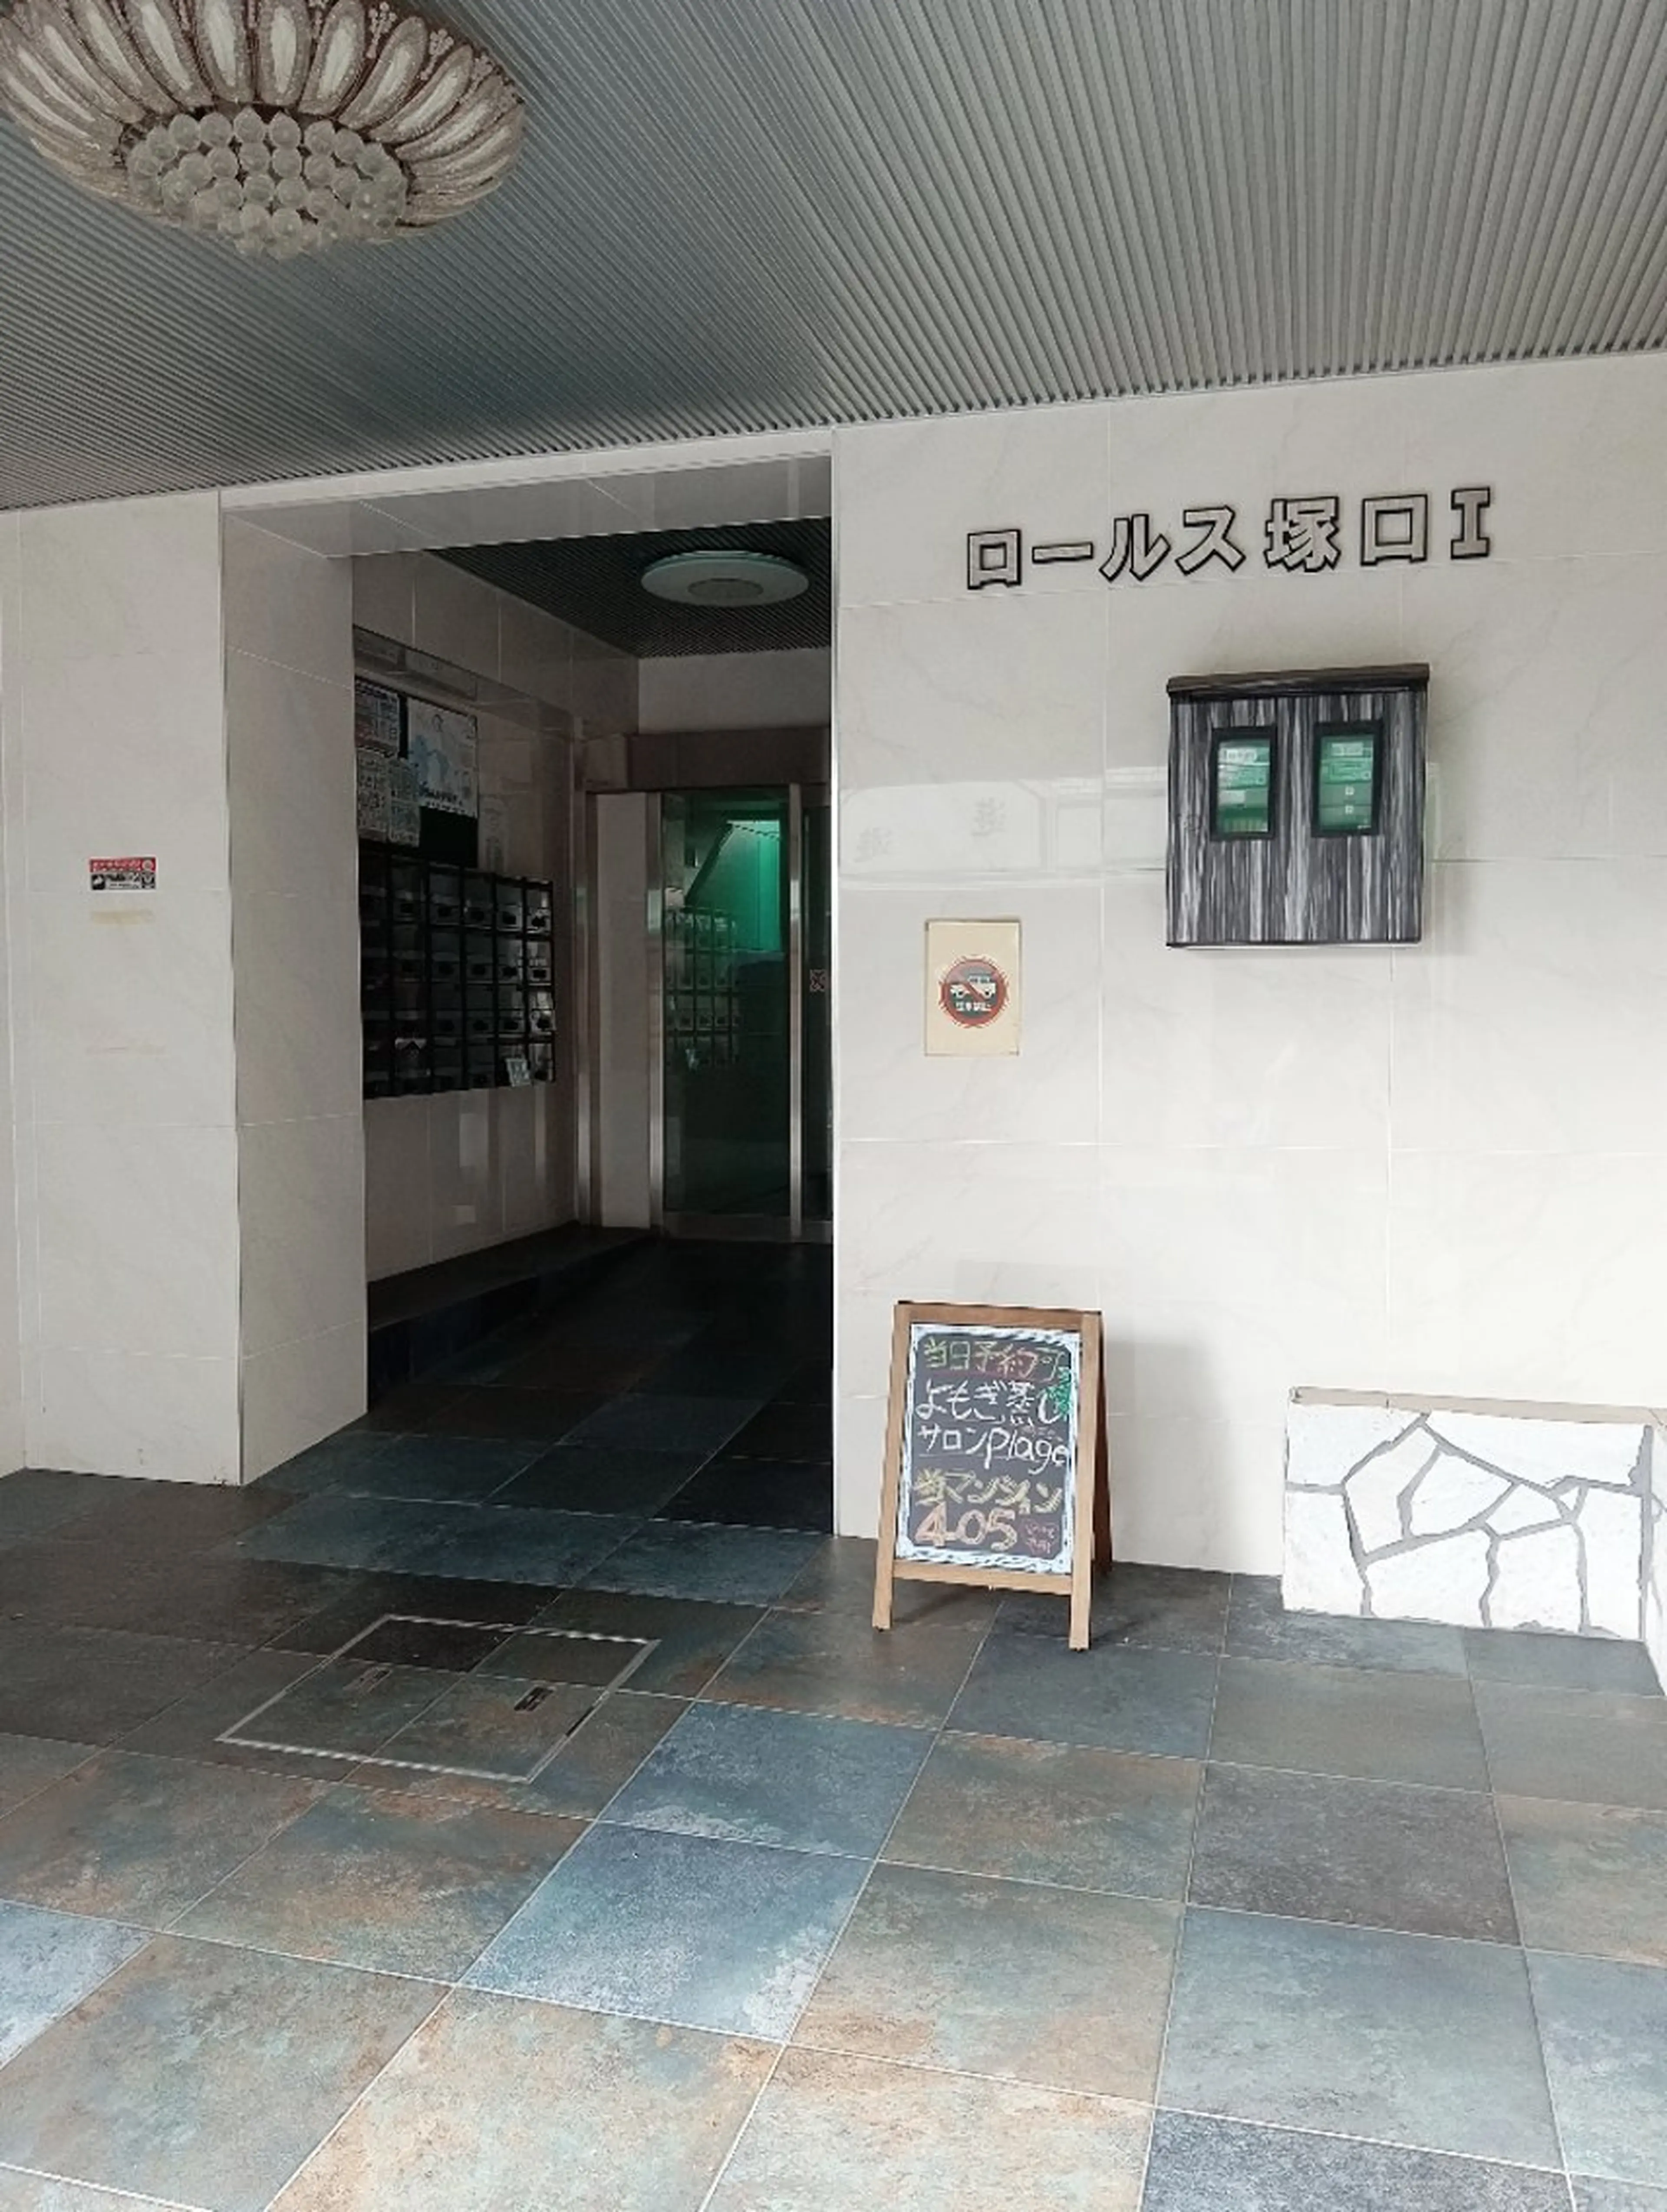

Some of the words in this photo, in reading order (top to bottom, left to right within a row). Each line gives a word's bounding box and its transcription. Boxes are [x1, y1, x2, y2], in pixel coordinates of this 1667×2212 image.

[924, 1336, 1065, 1383] 当日予約可
[915, 1378, 1063, 1426] よもぎ蒸し
[914, 1501, 1018, 1552] 405
